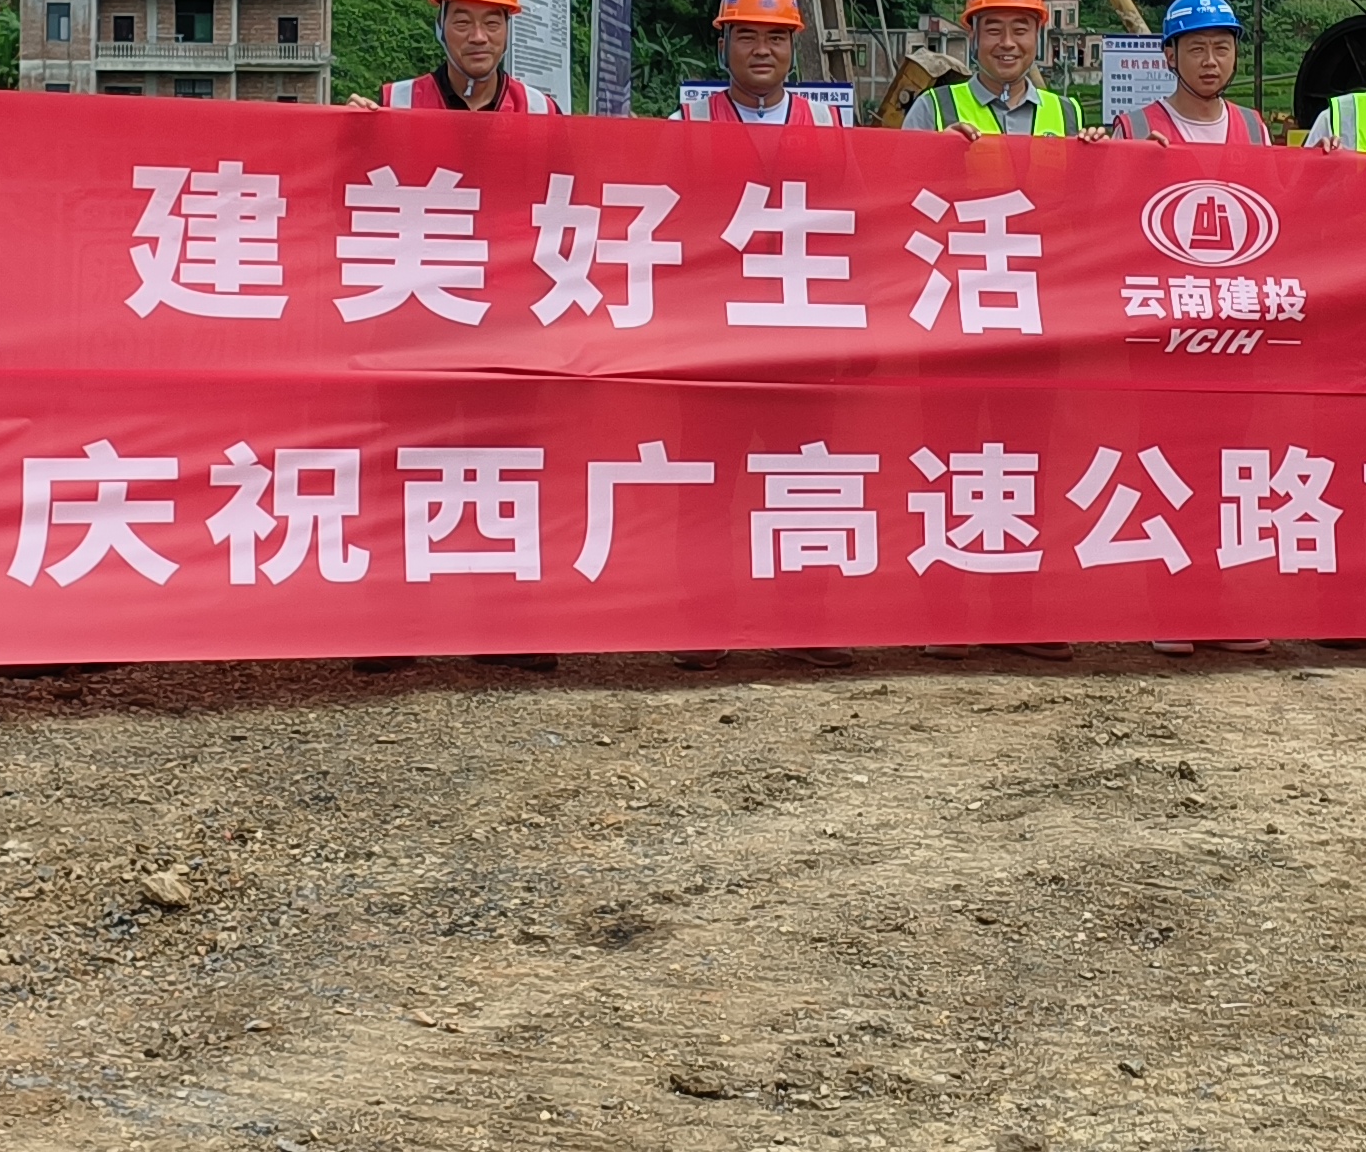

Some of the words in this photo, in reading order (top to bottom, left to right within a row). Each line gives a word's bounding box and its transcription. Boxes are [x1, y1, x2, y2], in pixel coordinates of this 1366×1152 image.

[123, 160, 1045, 336] 建美好生活
[1121, 275, 1307, 322] 云南建投
[1163, 328, 1265, 355] YCIH
